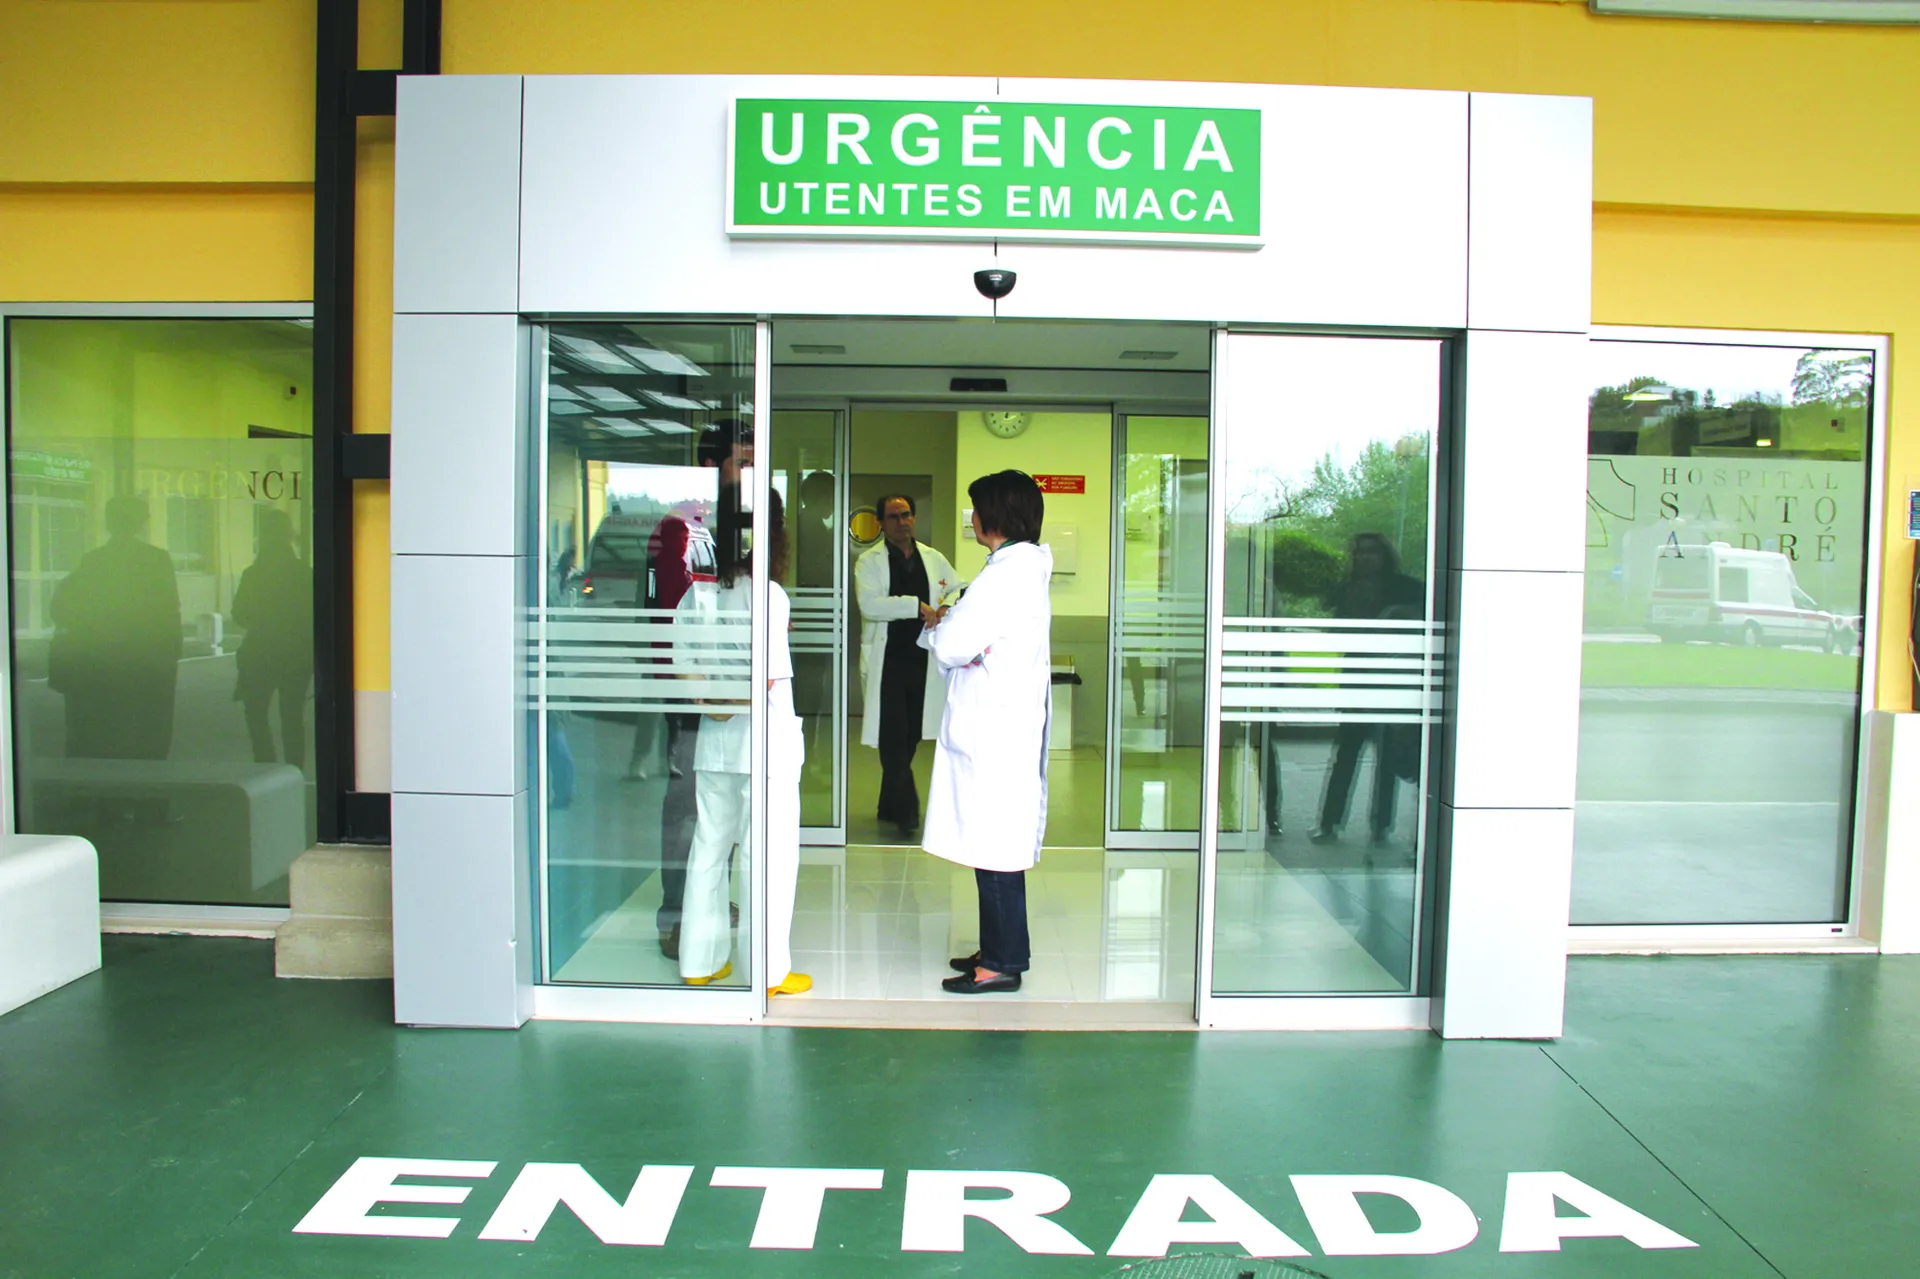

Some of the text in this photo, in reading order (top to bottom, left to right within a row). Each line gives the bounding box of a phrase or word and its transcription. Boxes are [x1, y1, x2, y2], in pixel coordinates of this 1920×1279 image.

[762, 104, 1234, 172] URGÊNCIA
[760, 182, 1234, 222] UTENTES EM MACA
[1661, 467, 1839, 490] HOSPITAL
[1659, 491, 1837, 525] SANTO
[292, 1157, 1700, 1258] ENTRADA
